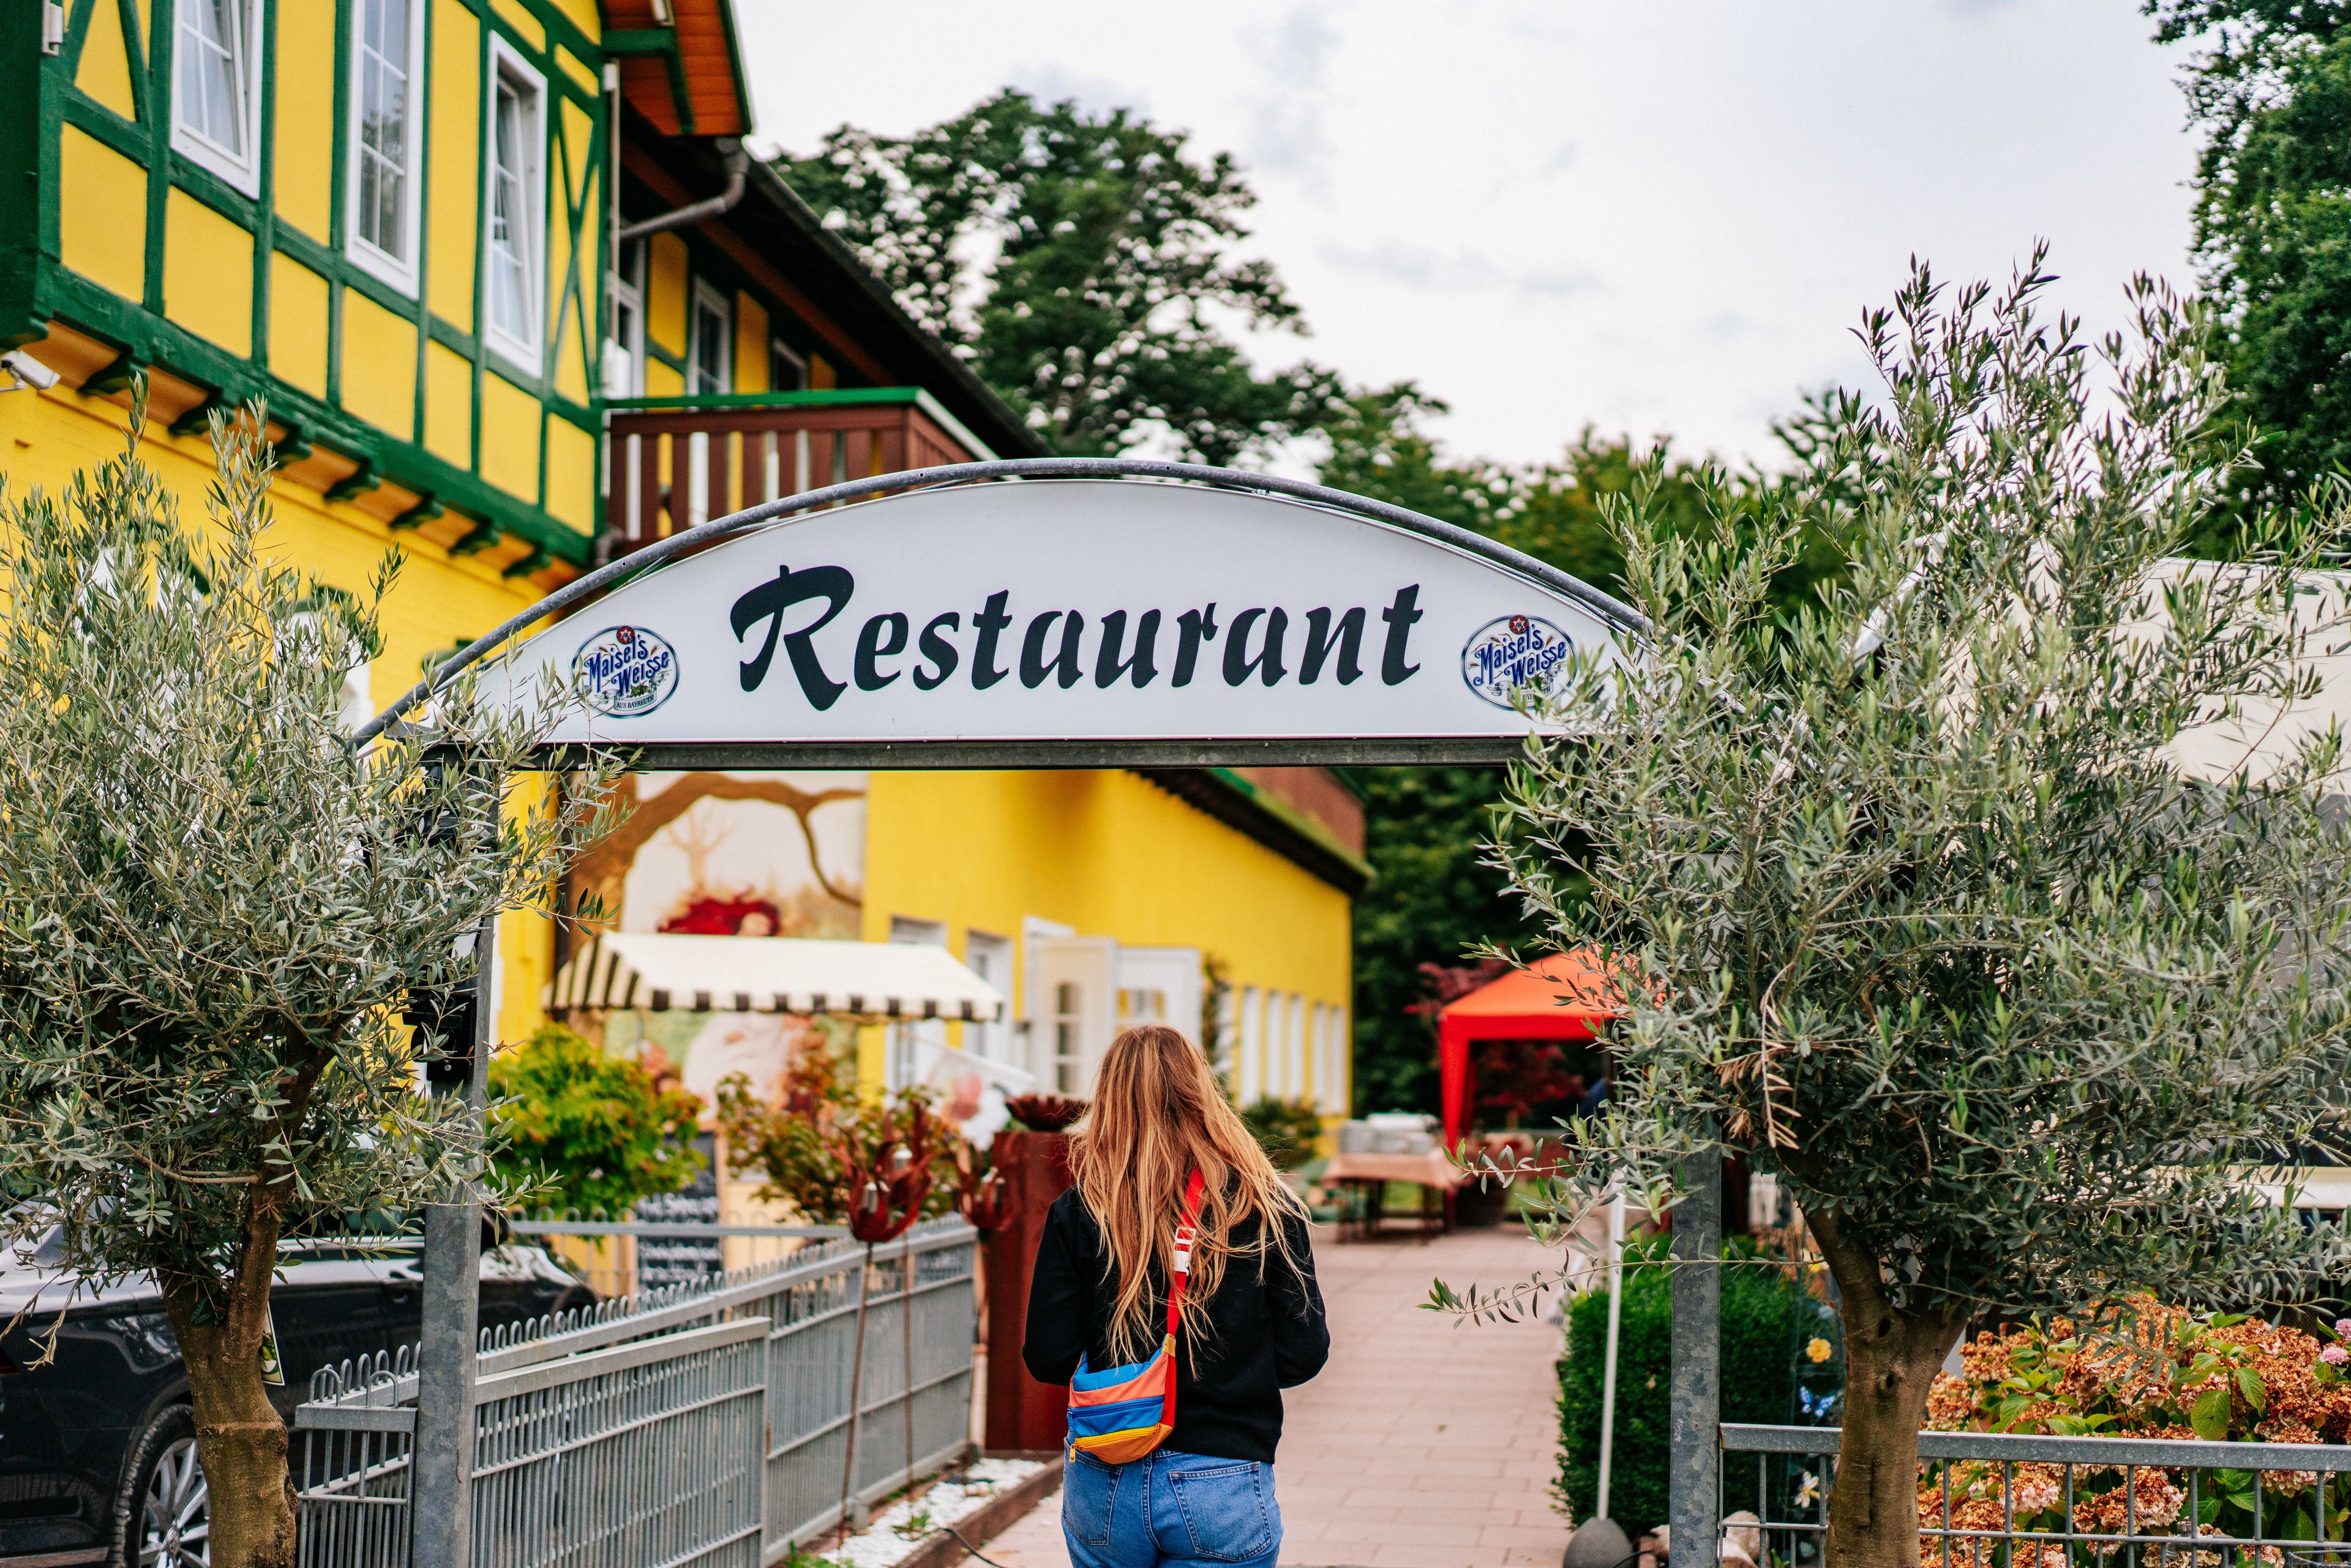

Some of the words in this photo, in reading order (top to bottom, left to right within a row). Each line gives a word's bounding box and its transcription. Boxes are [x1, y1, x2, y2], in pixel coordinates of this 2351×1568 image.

[583, 634, 648, 693] Maisel's
[730, 565, 1423, 711] Restaurant
[1473, 623, 1545, 686] Maisel's
[1504, 641, 1567, 687] Weisse
[611, 651, 670, 696] Weisse
[628, 694, 654, 708] BAYREUTH
